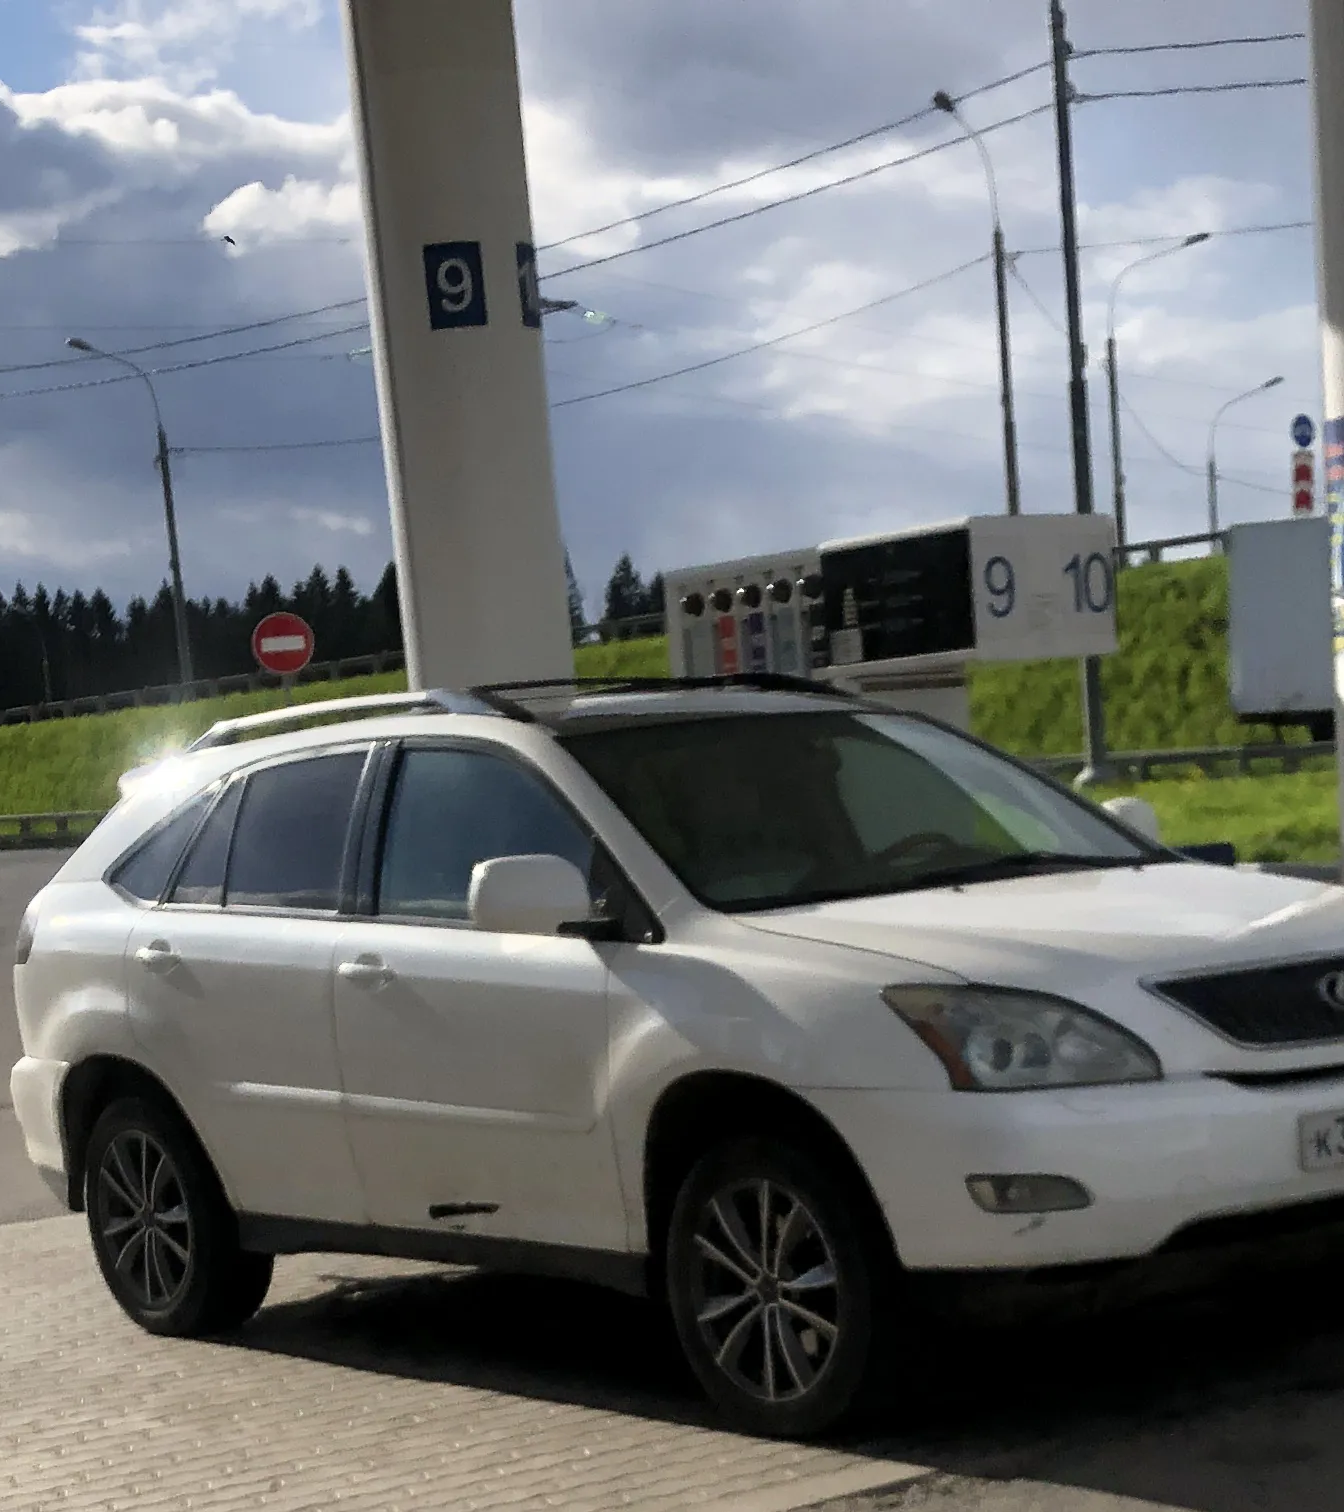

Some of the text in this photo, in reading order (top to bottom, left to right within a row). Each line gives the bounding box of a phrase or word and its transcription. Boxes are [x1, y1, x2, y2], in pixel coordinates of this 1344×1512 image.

[437, 258, 473, 312] 9
[983, 551, 1114, 618] 9 10
